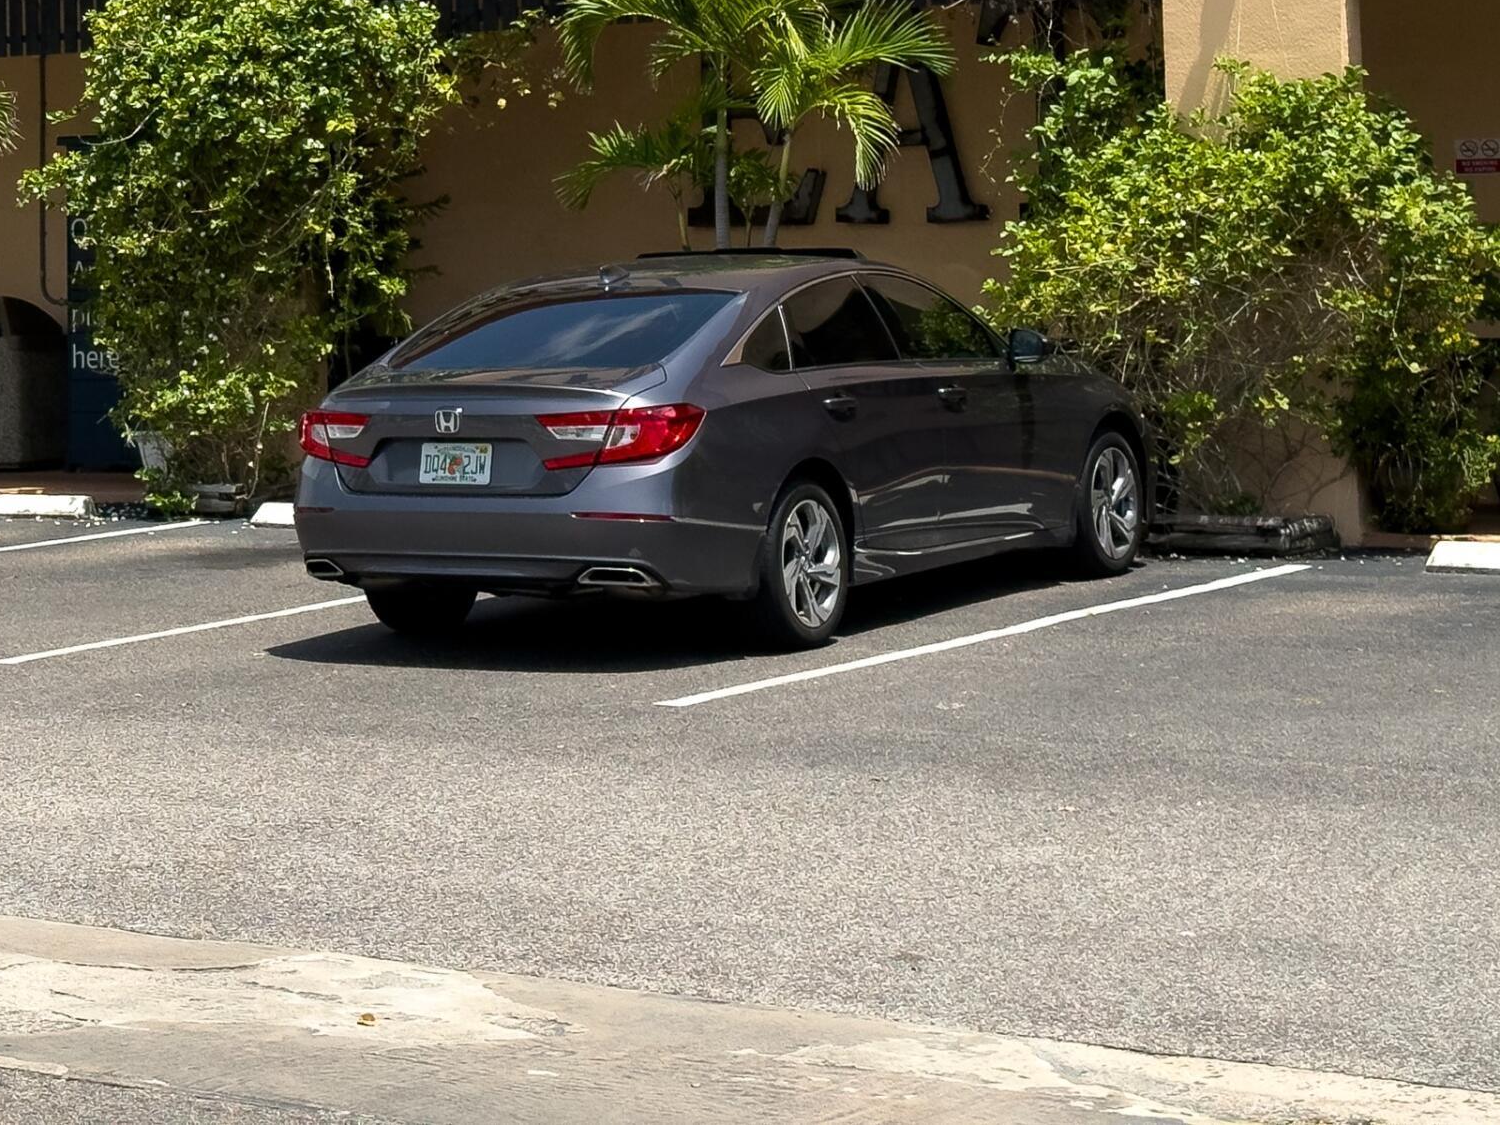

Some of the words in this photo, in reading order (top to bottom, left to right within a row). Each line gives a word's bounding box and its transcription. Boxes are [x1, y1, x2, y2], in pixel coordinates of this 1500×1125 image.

[72, 343, 120, 369] here
[424, 454, 447, 474] DQ4
[463, 455, 486, 475] 2JW
